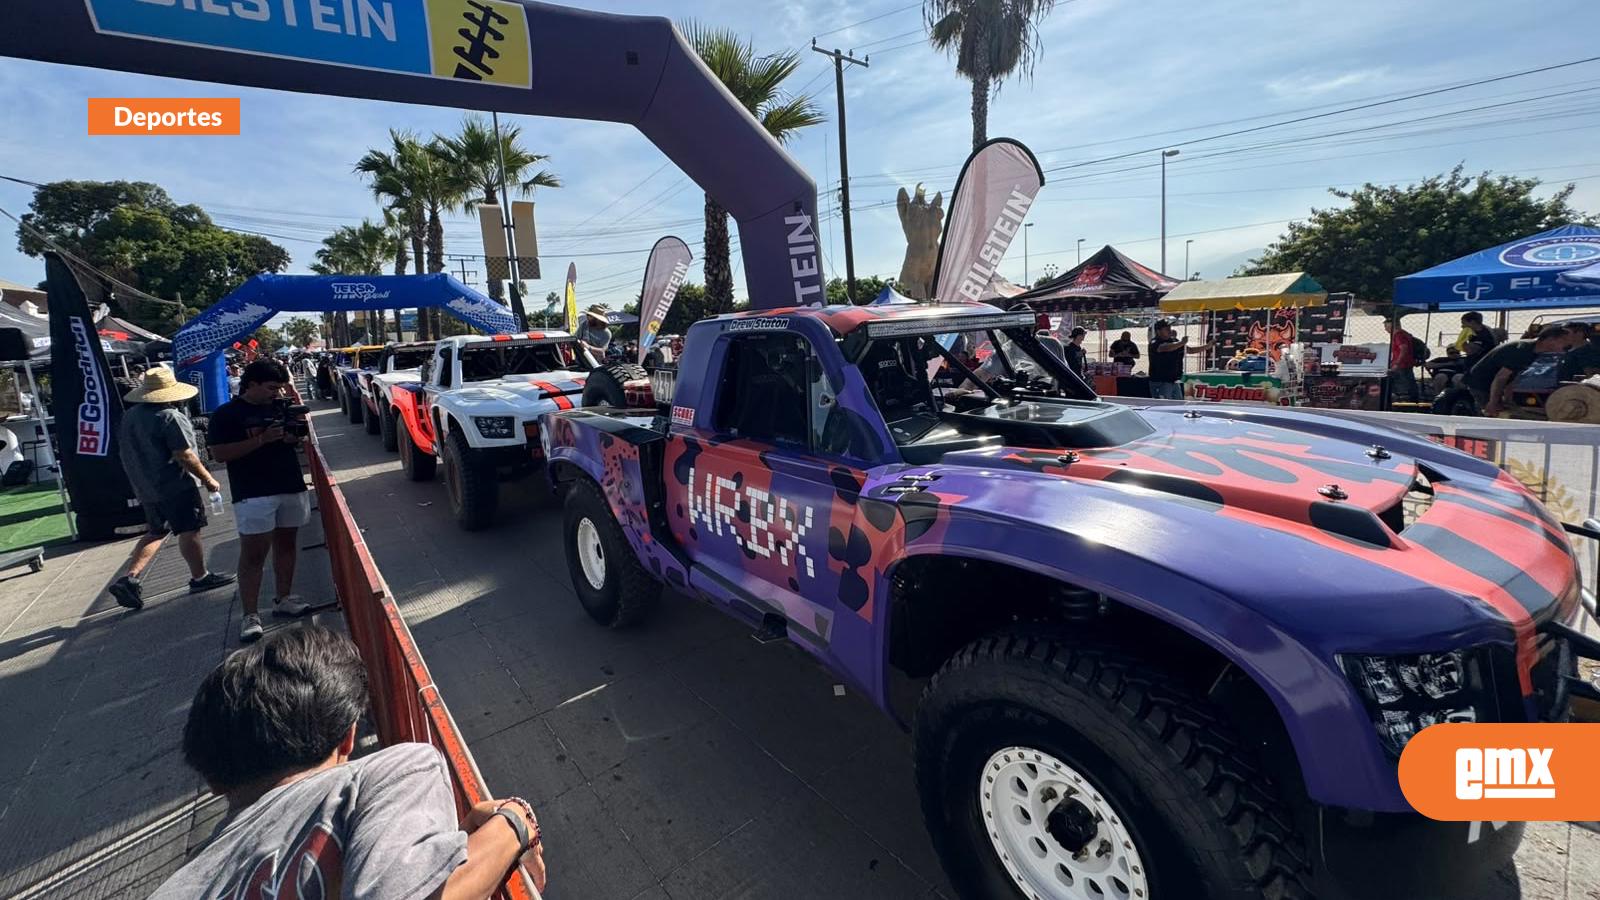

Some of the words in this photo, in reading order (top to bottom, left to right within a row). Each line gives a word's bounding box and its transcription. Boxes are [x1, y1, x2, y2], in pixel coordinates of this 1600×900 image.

[784, 215, 822, 308] TEIN
[960, 190, 1033, 302] BILSTEIN
[331, 283, 376, 293] TERSA
[654, 261, 689, 320] BILSTEIN
[730, 320, 753, 330] Drew
[753, 318, 790, 329] Staton
[69, 316, 102, 455] BFGoodrich
[673, 406, 694, 420] SCORE
[1194, 384, 1265, 401] Tejuino
[688, 467, 815, 578] WRBX
